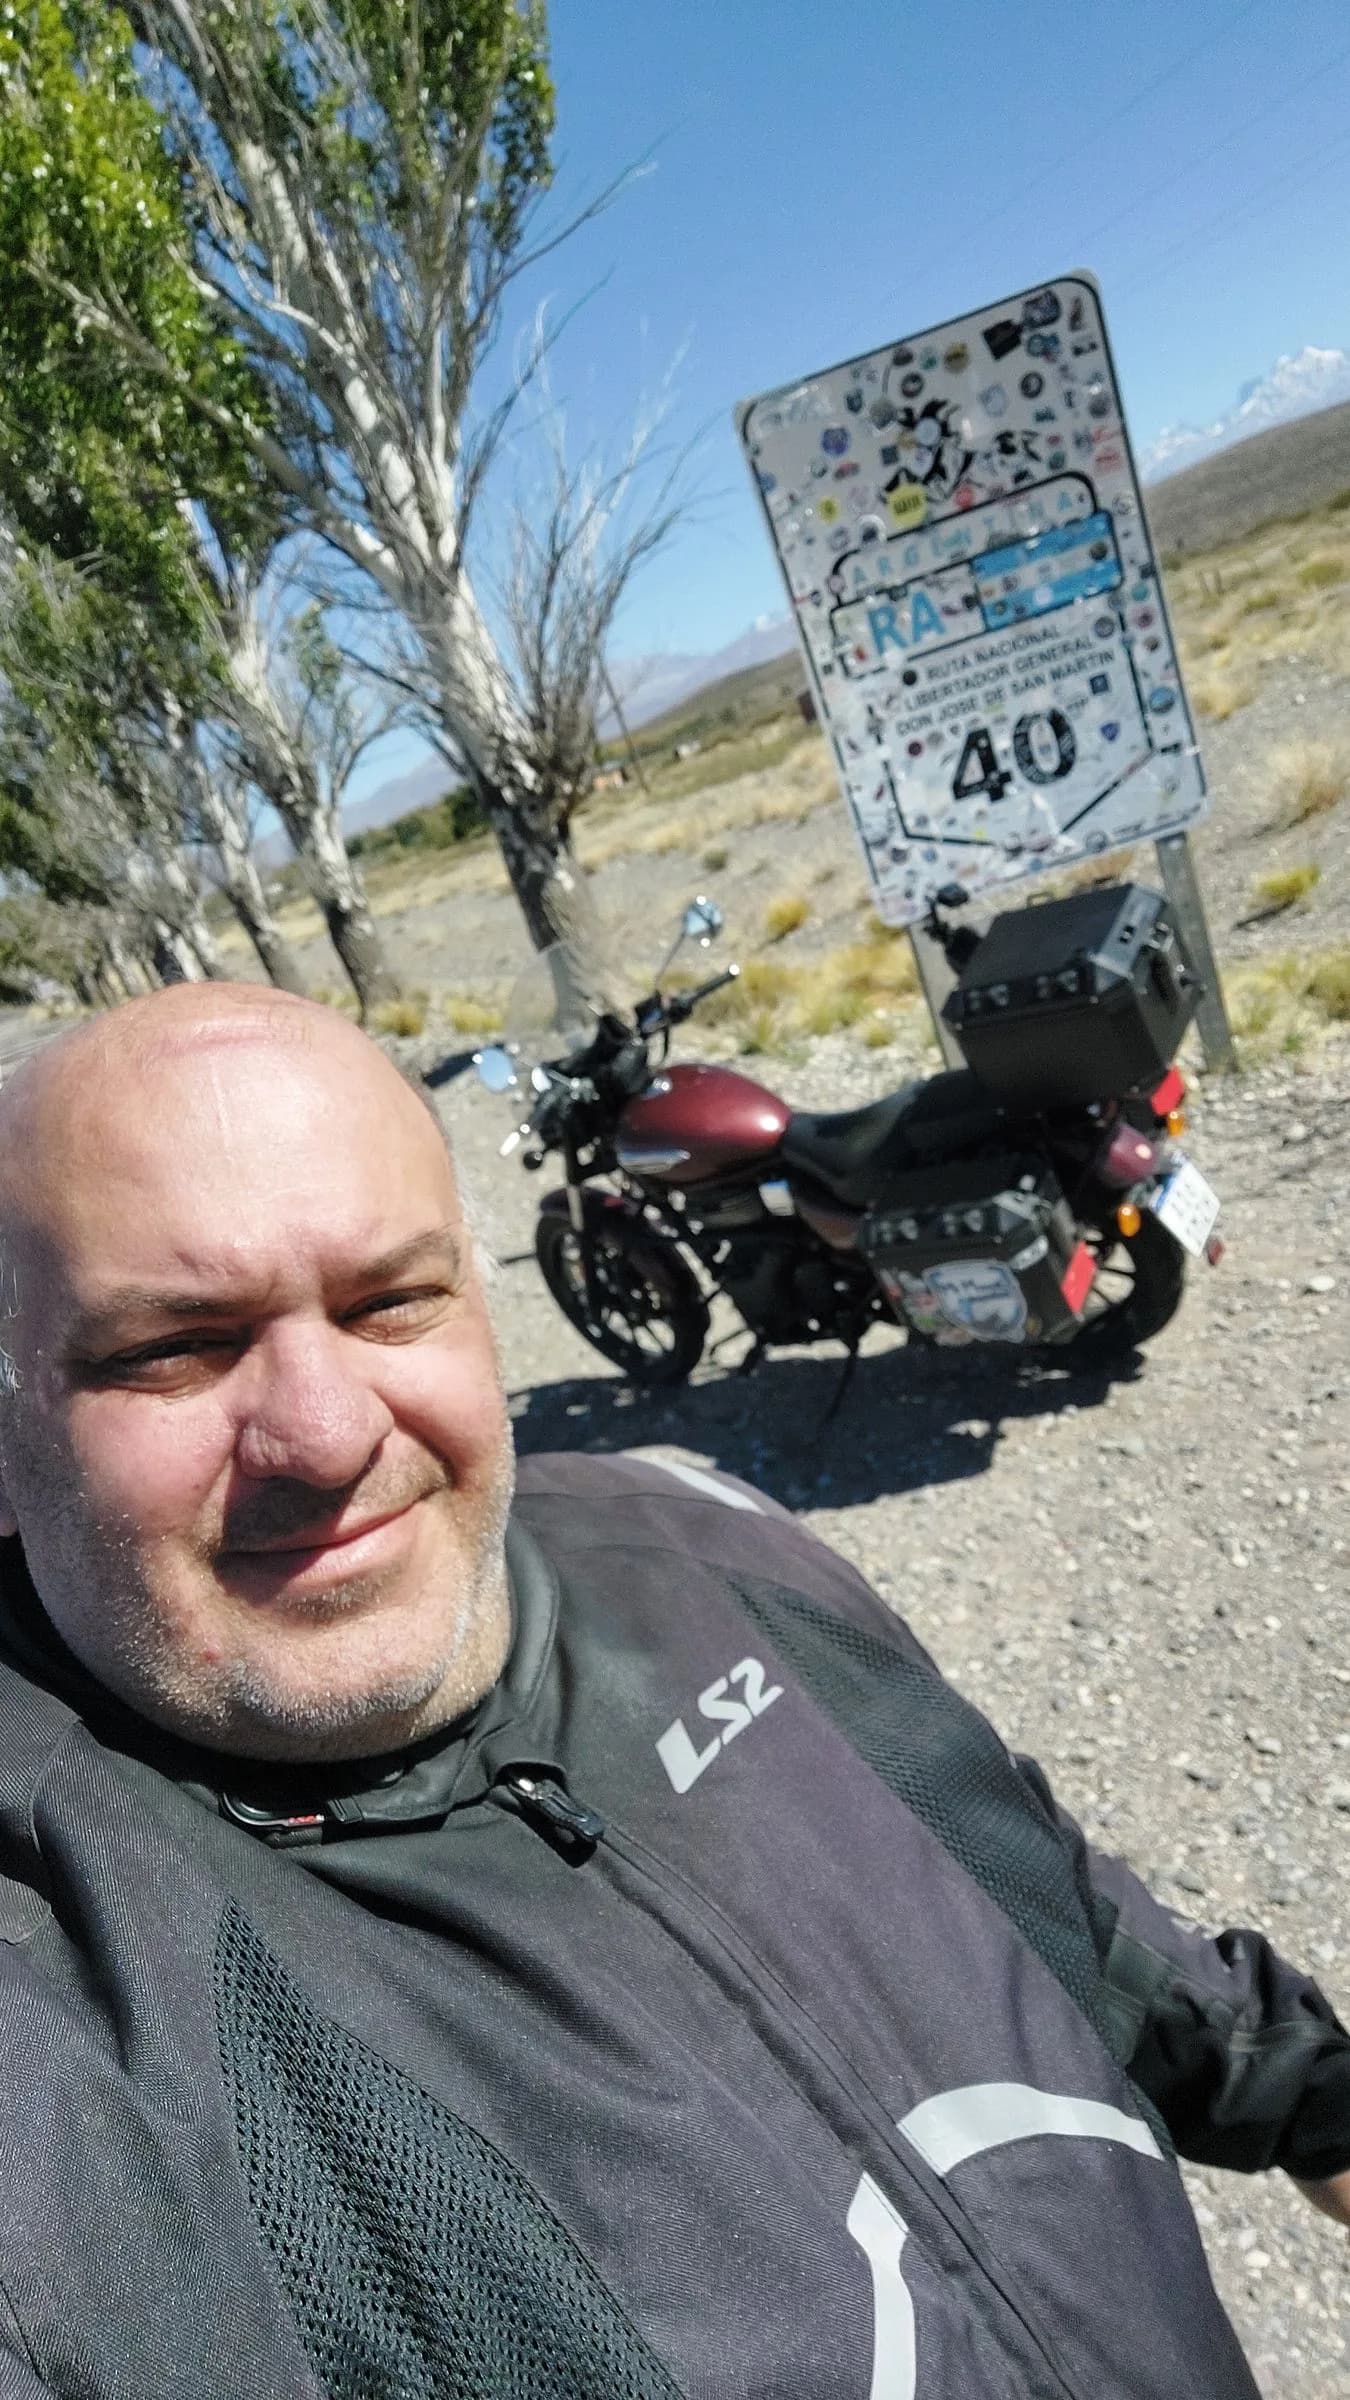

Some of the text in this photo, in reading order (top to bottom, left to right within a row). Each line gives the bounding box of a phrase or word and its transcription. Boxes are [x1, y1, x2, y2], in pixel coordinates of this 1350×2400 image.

[865, 590, 946, 656] RA
[926, 626, 1060, 681] RUTA NACIONAL
[896, 712, 933, 737] DON
[983, 688, 1004, 706] DE
[1011, 674, 1047, 696] SAN
[904, 638, 1094, 712] LIBERTADOR GENERAL
[655, 656, 785, 795] LS2
[953, 708, 1077, 801] 40
